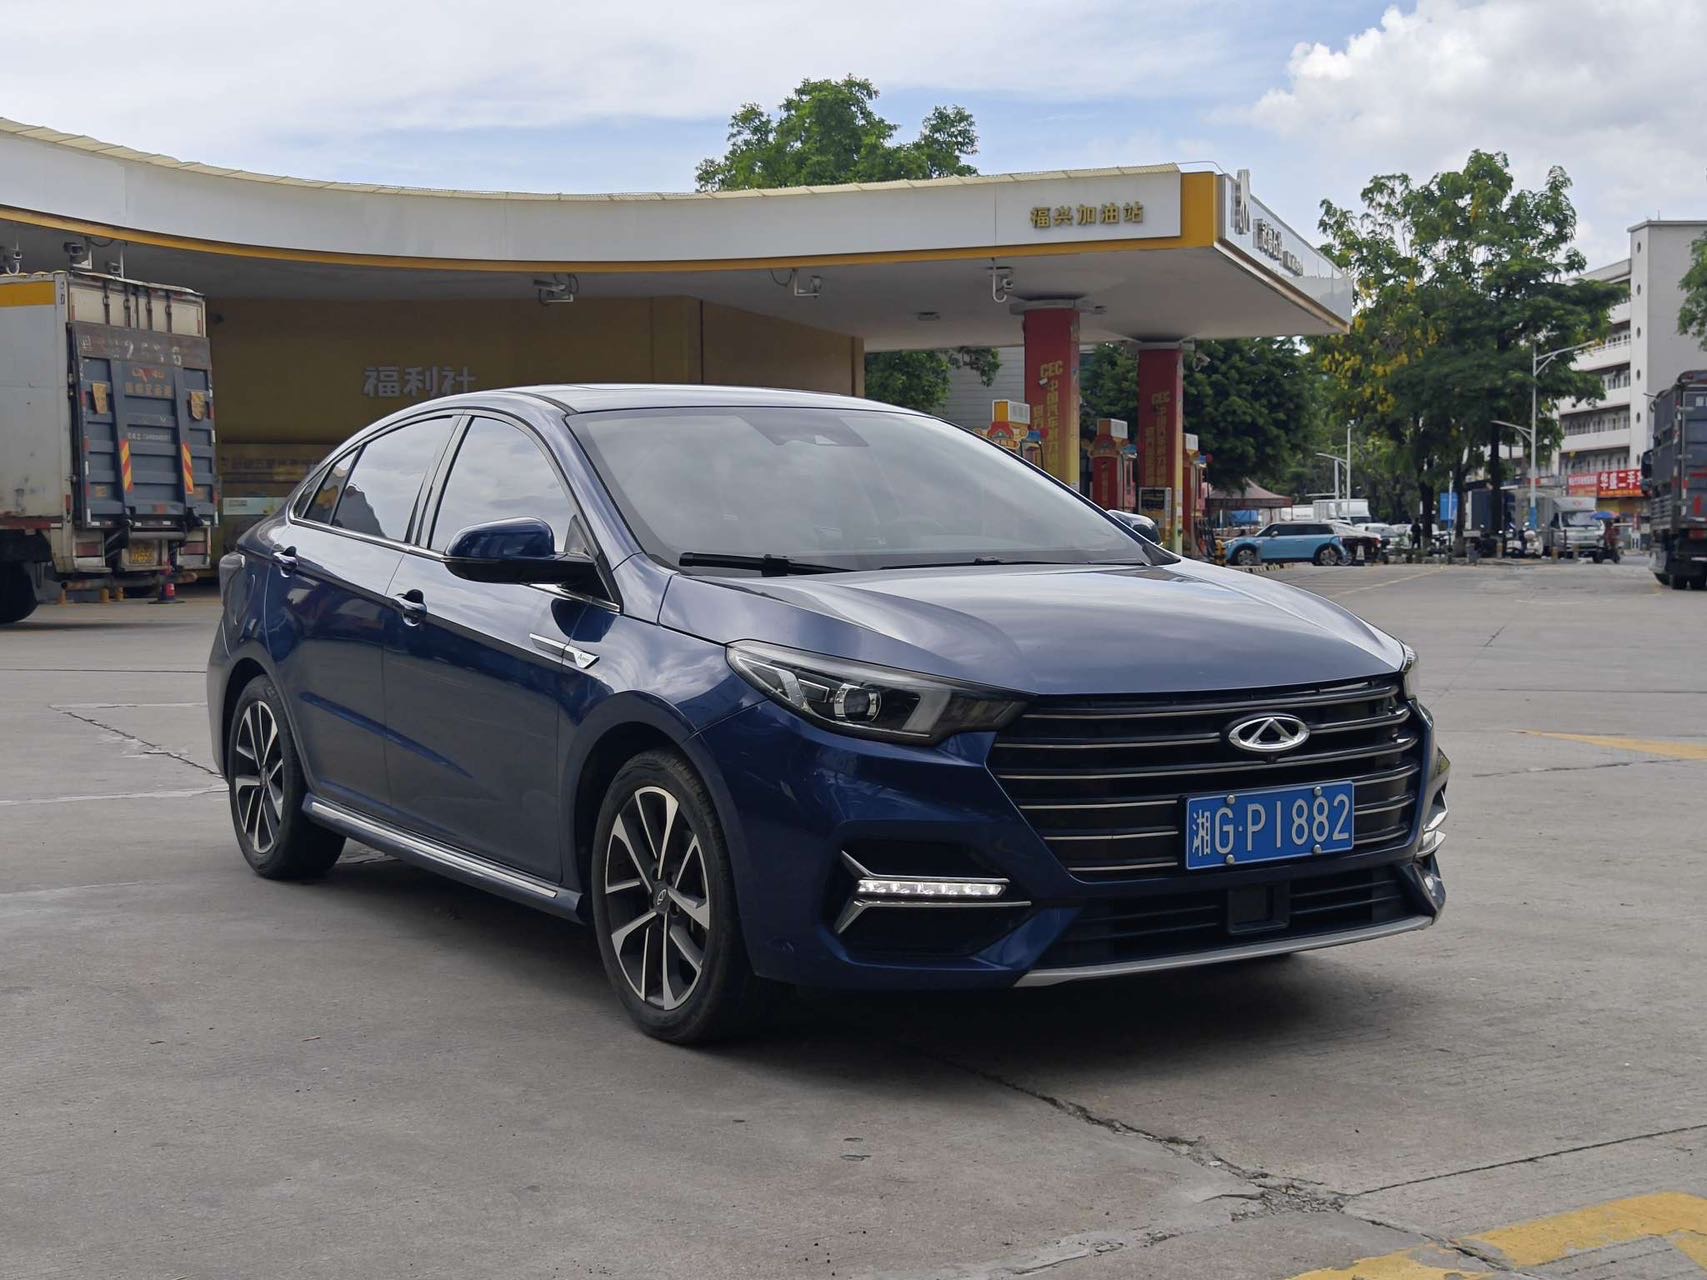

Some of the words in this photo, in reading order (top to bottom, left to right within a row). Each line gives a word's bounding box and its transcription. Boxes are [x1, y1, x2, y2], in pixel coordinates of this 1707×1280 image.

[1031, 201, 1144, 229] 福兴加油站
[363, 366, 477, 397] 福利社
[1041, 360, 1063, 377] CEC
[1192, 793, 1350, 857] 湘G·P1882
